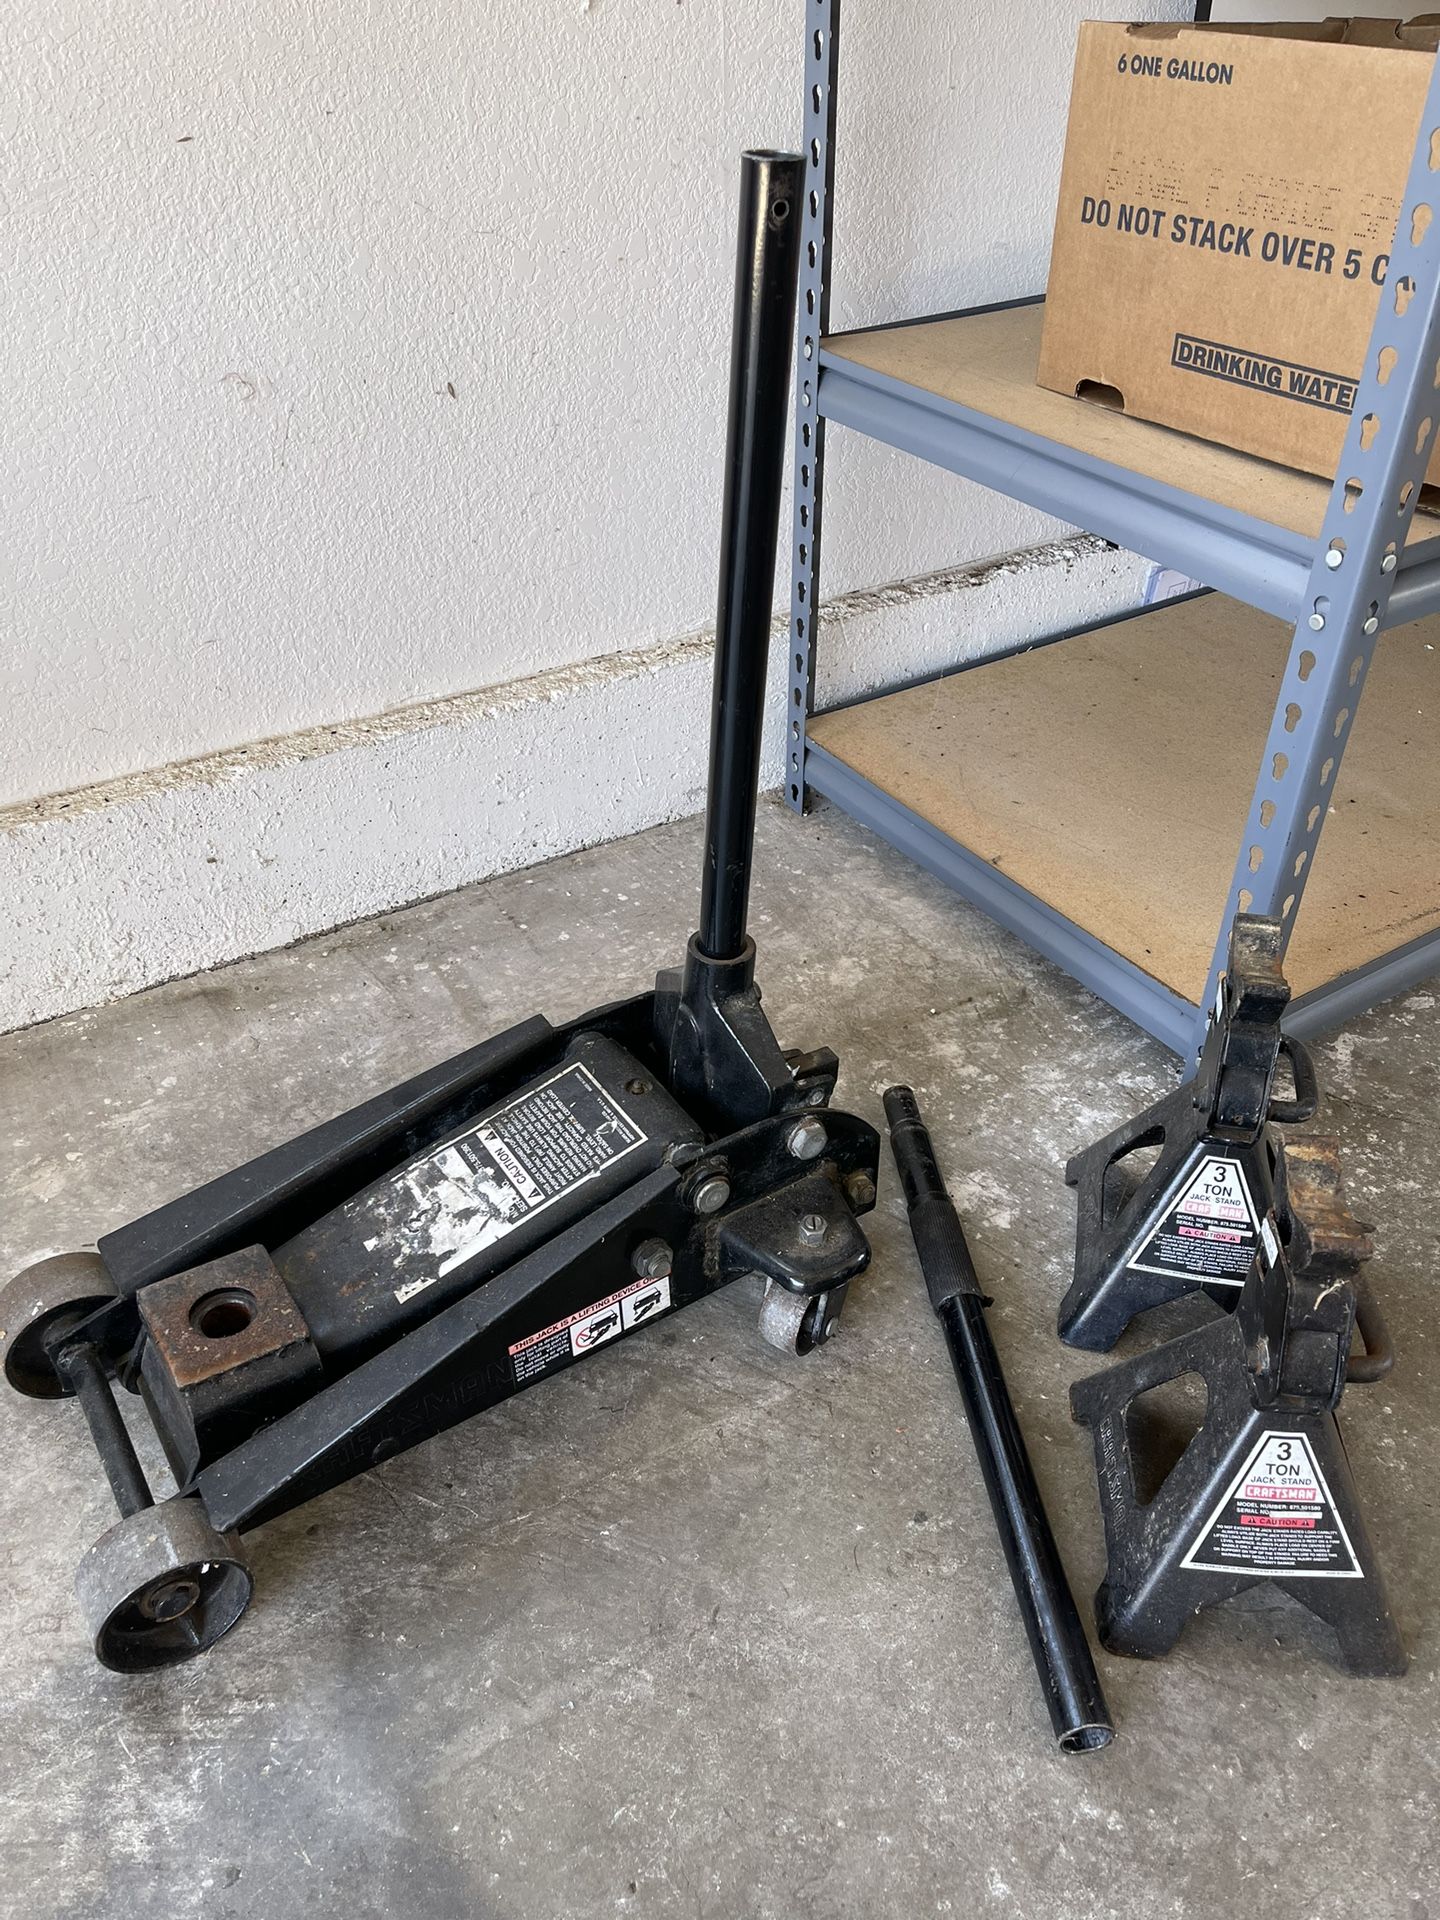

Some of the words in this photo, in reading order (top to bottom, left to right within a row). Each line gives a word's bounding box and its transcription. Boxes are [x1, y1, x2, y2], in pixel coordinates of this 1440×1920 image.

[1117, 54, 1127, 74] 6
[1131, 54, 1162, 78] ONE
[1166, 57, 1234, 85] GALLON
[1081, 196, 1110, 227] DO
[1117, 205, 1166, 238] NOT
[1171, 214, 1255, 257] STACK
[1261, 231, 1335, 274] OVER
[1342, 250, 1362, 279] 5
[1178, 342, 1283, 388] DRINKING
[1289, 373, 1359, 408] WATE
[493, 1147, 527, 1185] CAUTION
[533, 1171, 546, 1184] JACK
[1214, 1166, 1227, 1182] 3
[542, 1182, 554, 1195] THIS
[1203, 1184, 1232, 1197] TON
[1190, 1194, 1210, 1202] JACK
[1215, 1197, 1241, 1206] STAND
[1176, 1214, 1195, 1222] MODEL
[1194, 1230, 1226, 1240] CAUTION
[514, 1336, 534, 1352] THIS
[535, 1323, 558, 1341] JACK
[560, 1318, 568, 1328] IS
[570, 1313, 578, 1322] A
[578, 1296, 609, 1318] LIFTING
[611, 1280, 640, 1301] DEVICE
[1277, 1442, 1292, 1460] 3
[1266, 1463, 1300, 1476] TON
[1250, 1476, 1276, 1484] JACK
[1281, 1478, 1312, 1486] STAND
[1246, 1485, 1315, 1500] CRAFTSMAN
[1237, 1501, 1259, 1509] MODEL
[1259, 1518, 1298, 1526] CAUTION
